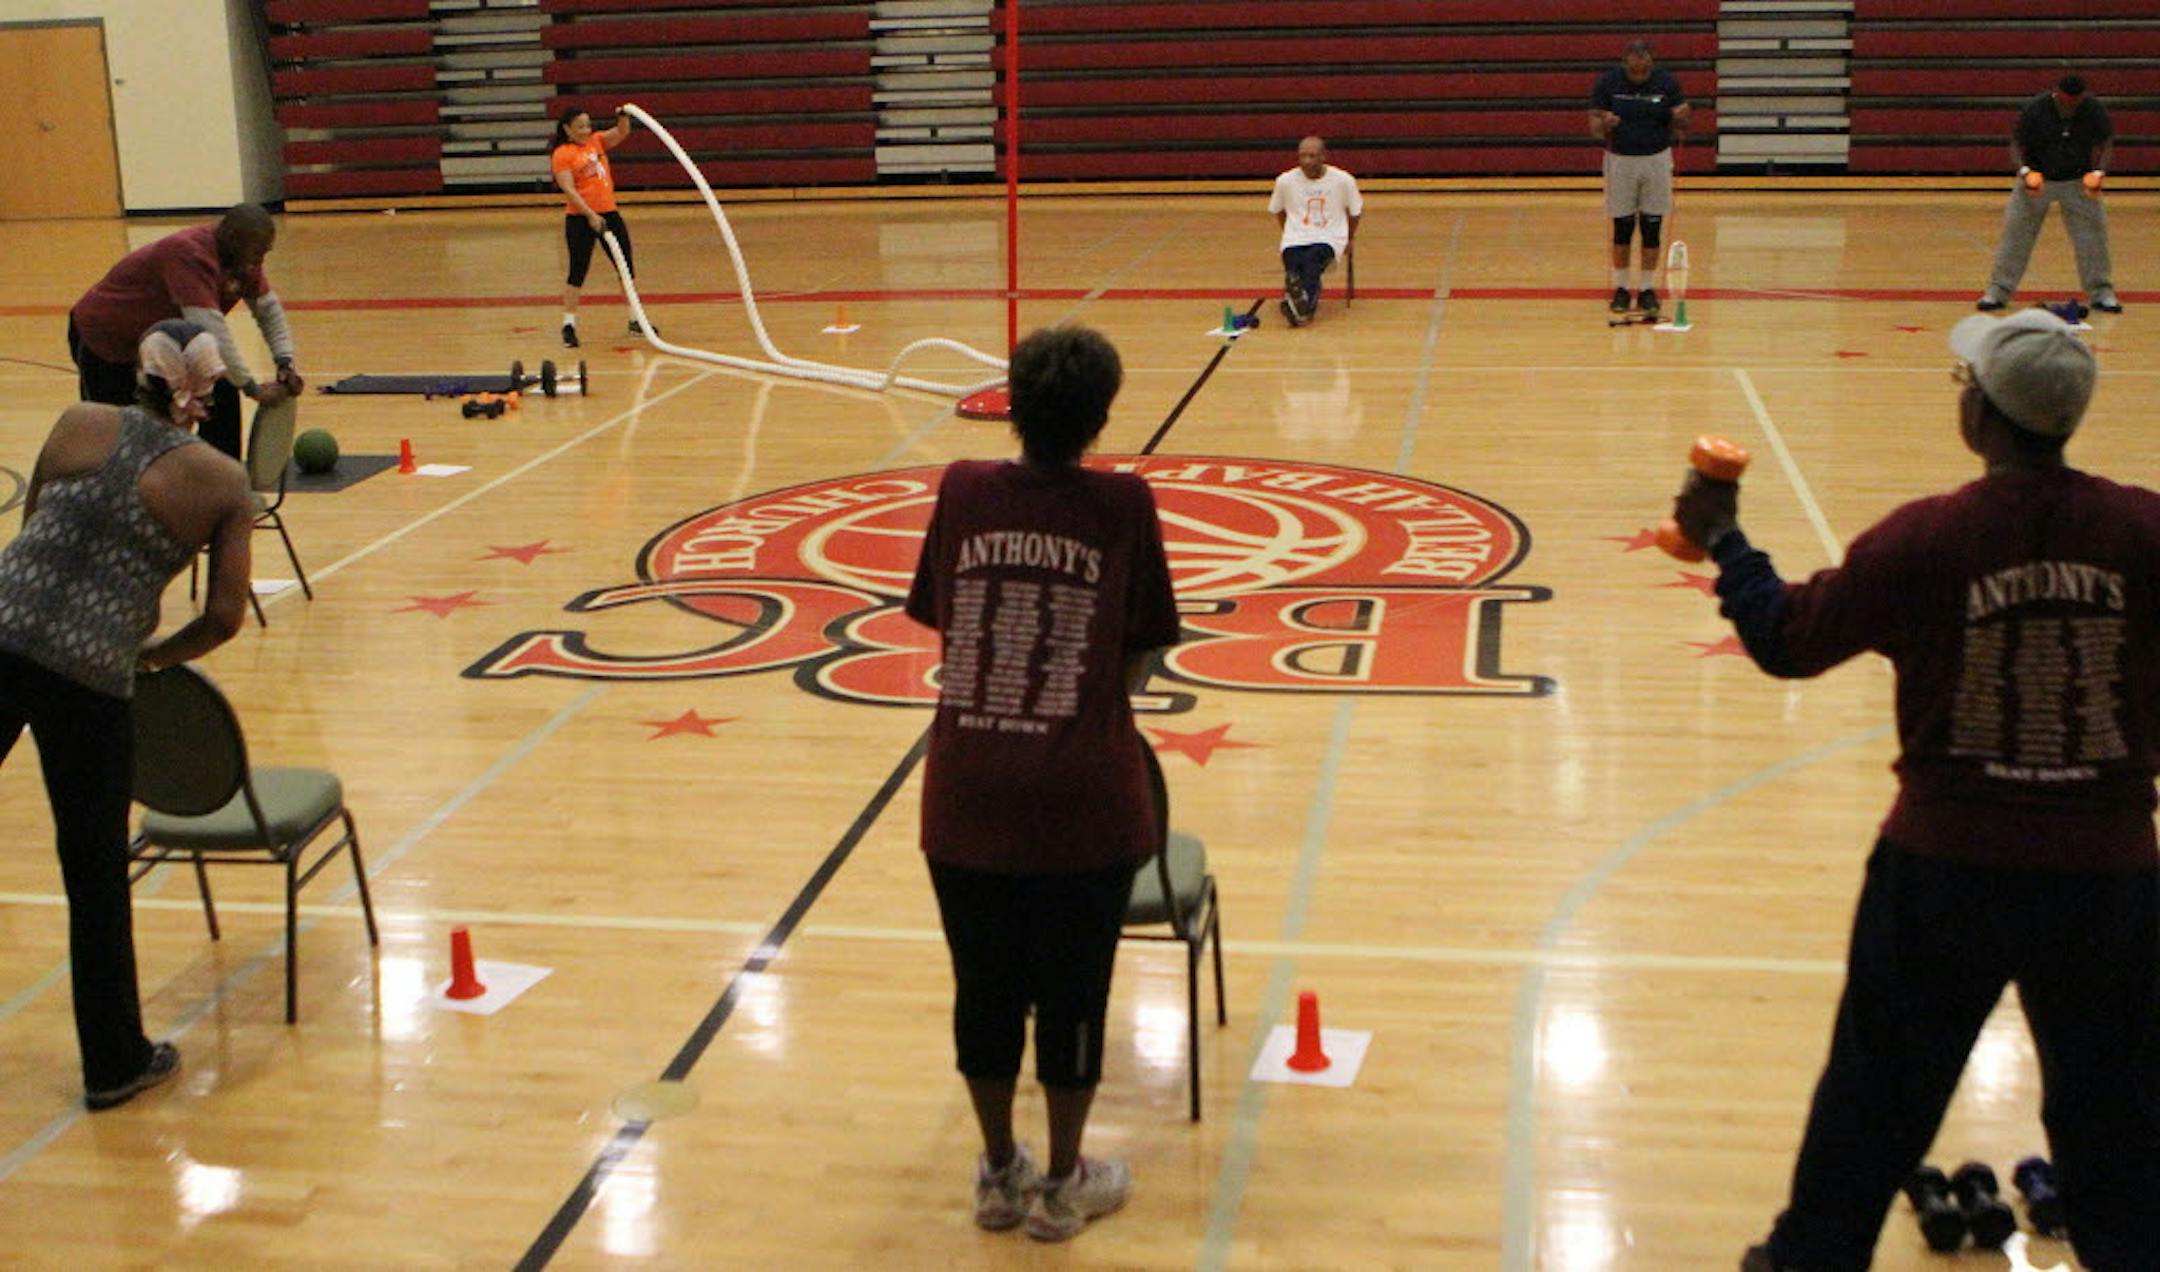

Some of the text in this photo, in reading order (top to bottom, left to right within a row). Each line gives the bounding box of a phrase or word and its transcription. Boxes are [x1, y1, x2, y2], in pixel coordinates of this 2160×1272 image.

[672, 479, 928, 574] CHURCH
[955, 530, 1102, 584] ANTHONY'S
[1316, 482, 1492, 580] BEULAH
